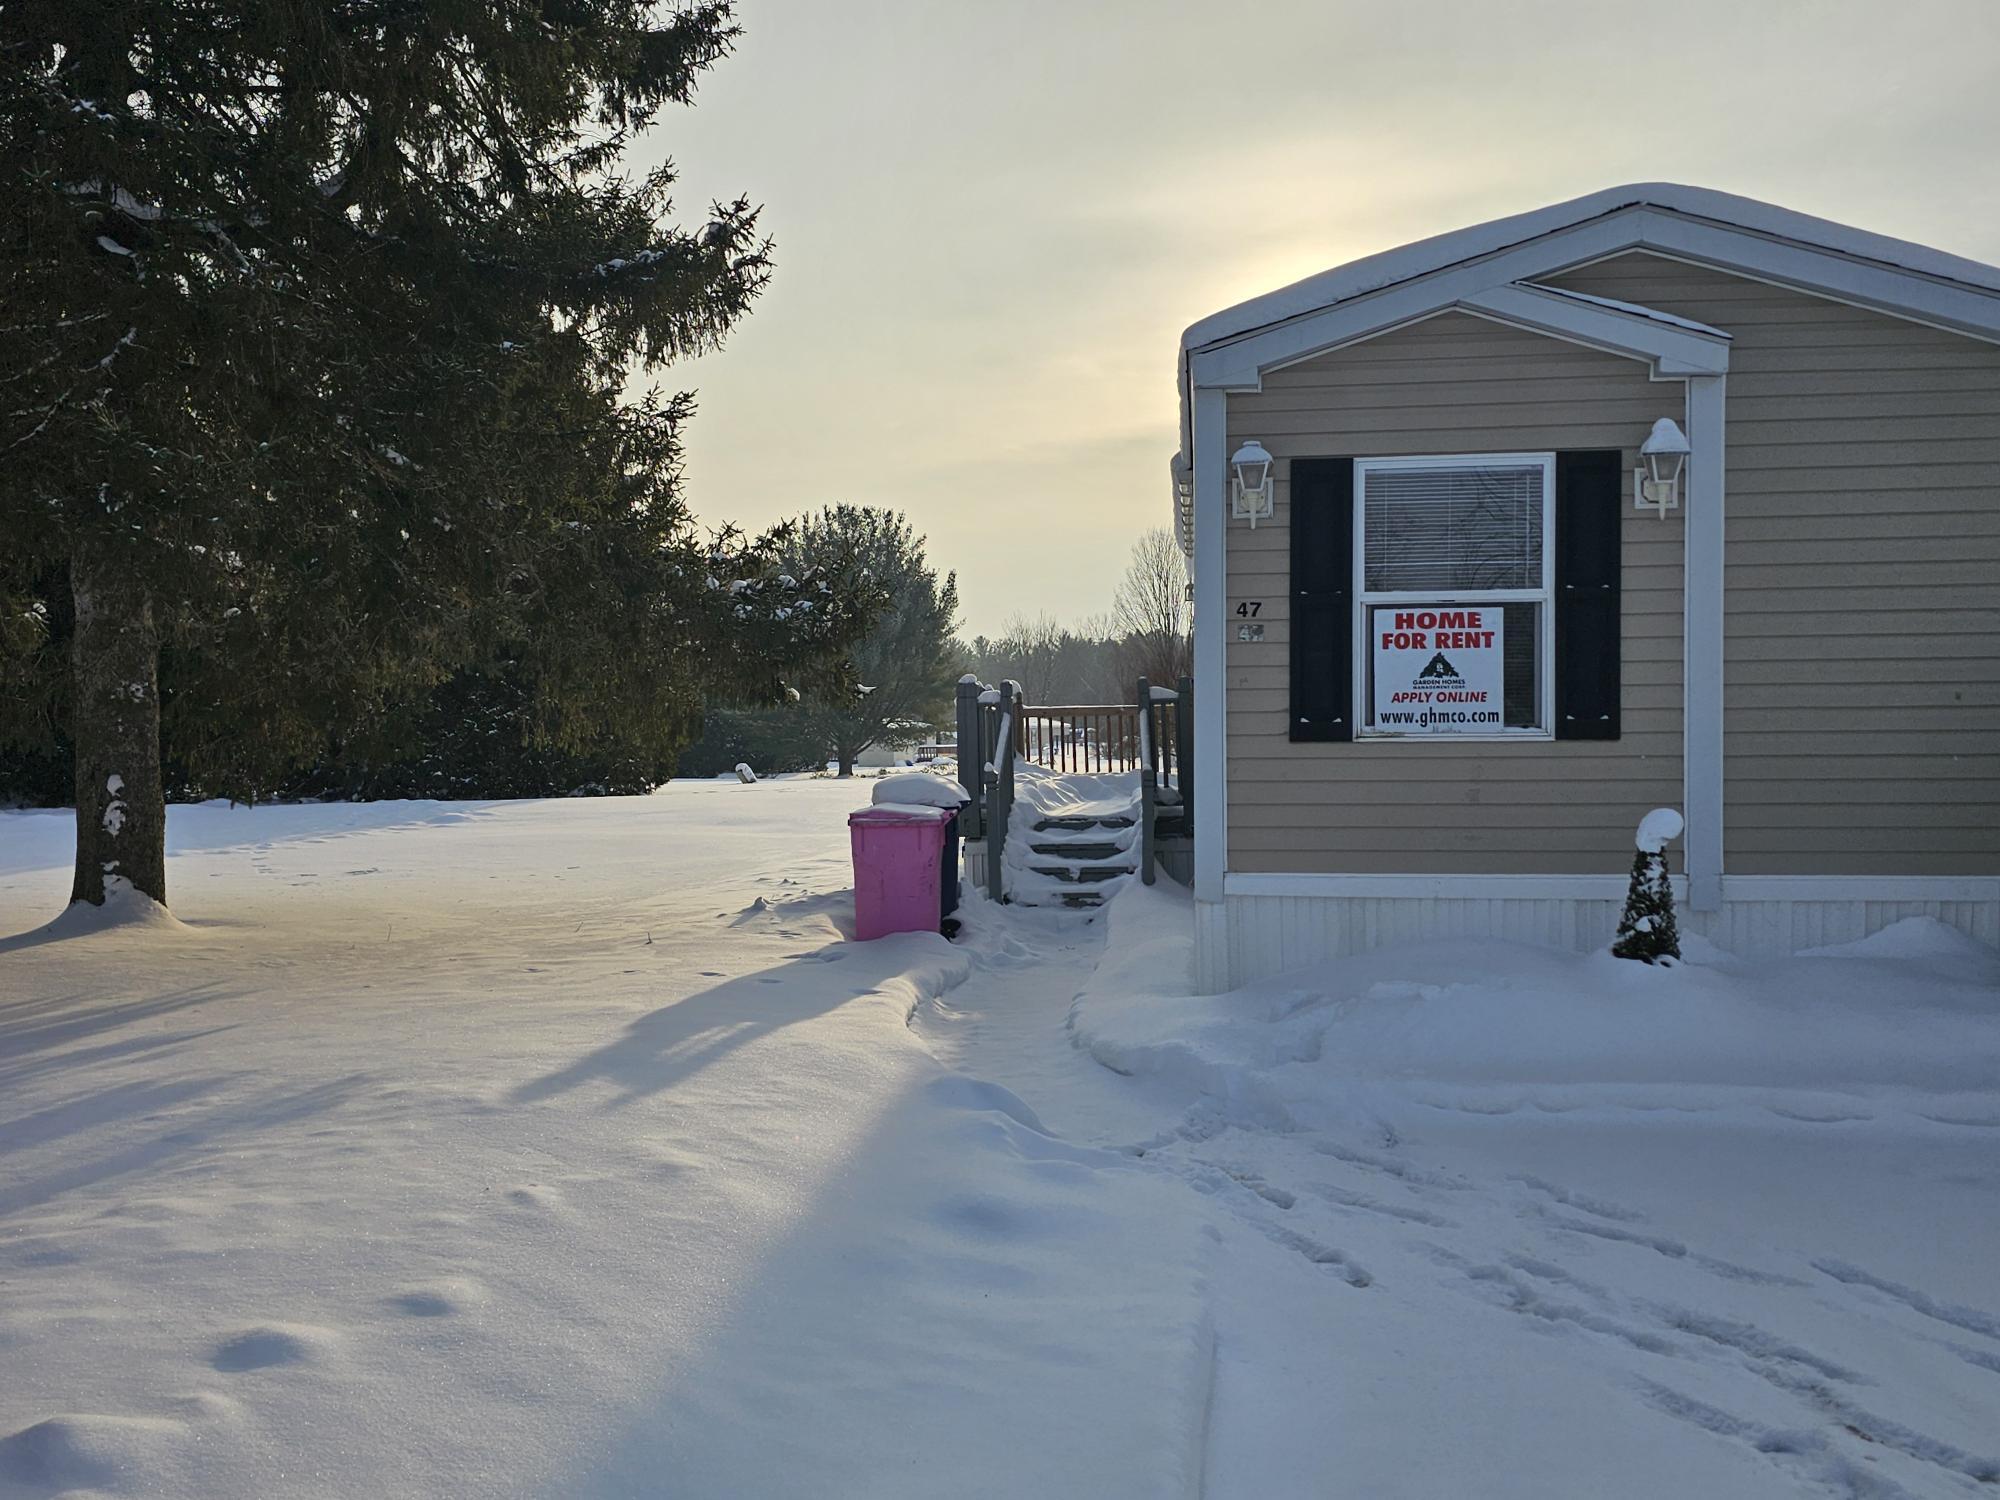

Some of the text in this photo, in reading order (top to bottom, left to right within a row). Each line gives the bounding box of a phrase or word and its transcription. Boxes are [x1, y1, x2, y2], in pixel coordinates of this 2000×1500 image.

[1236, 602, 1262, 617] 47
[1395, 612, 1482, 630] HOME
[1382, 631, 1495, 650] FOR RENT
[1391, 691, 1488, 703] APPLY ONLINE
[1380, 707, 1500, 728] www.ghmco.com
